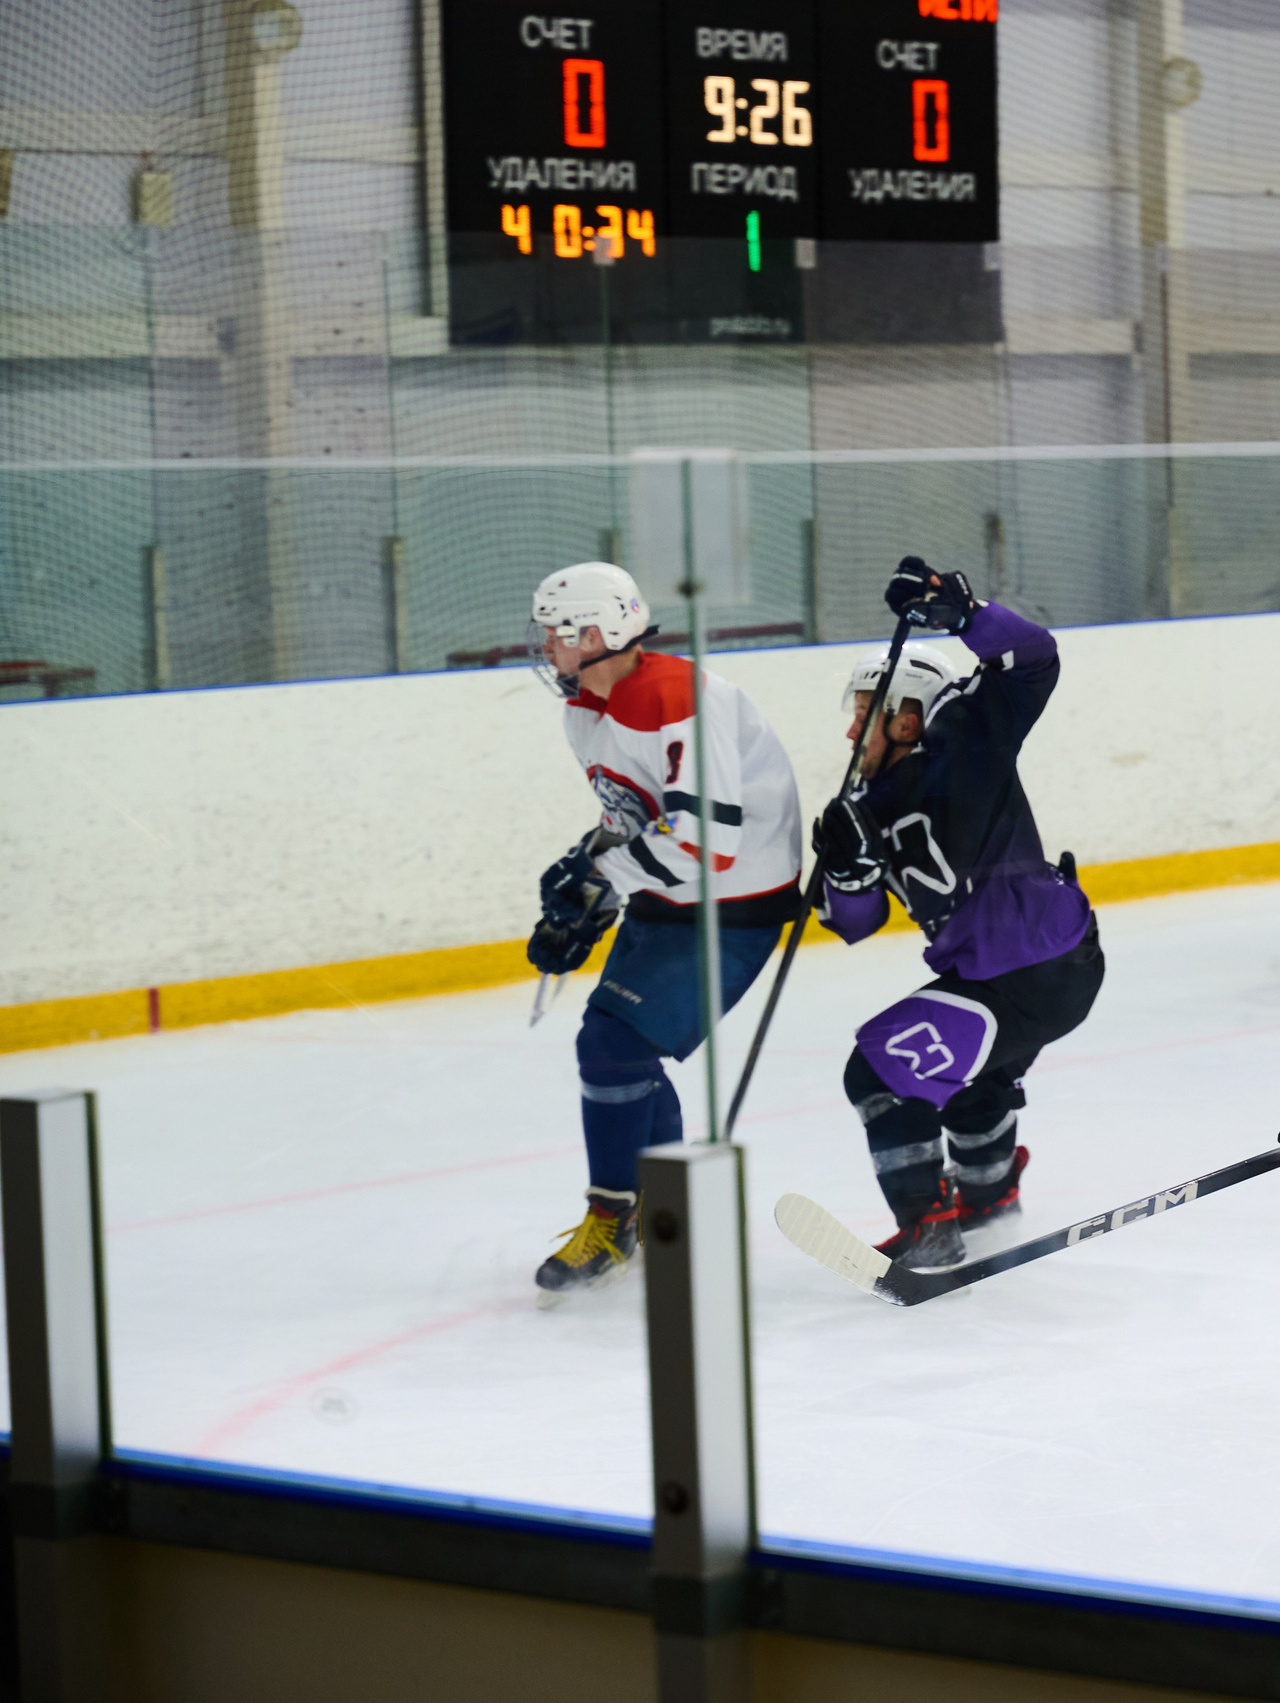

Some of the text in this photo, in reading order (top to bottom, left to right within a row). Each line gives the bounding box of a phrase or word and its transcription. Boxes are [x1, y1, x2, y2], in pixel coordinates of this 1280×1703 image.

[521, 15, 593, 50] СЧЕТ
[696, 27, 787, 62] ВРЕМЯ
[876, 40, 939, 71] СЧЕТ
[563, 58, 606, 148] 0
[704, 76, 812, 146] 9:26
[912, 79, 949, 162] 0
[488, 156, 636, 192] УДАЛЕНИЯ
[692, 163, 797, 198] ПЕРИОД
[849, 168, 976, 200] УДАЛЕНИЯ
[501, 204, 656, 258] 4 0:34
[746, 210, 760, 272] 1
[1066, 1180, 1199, 1247] CCM
